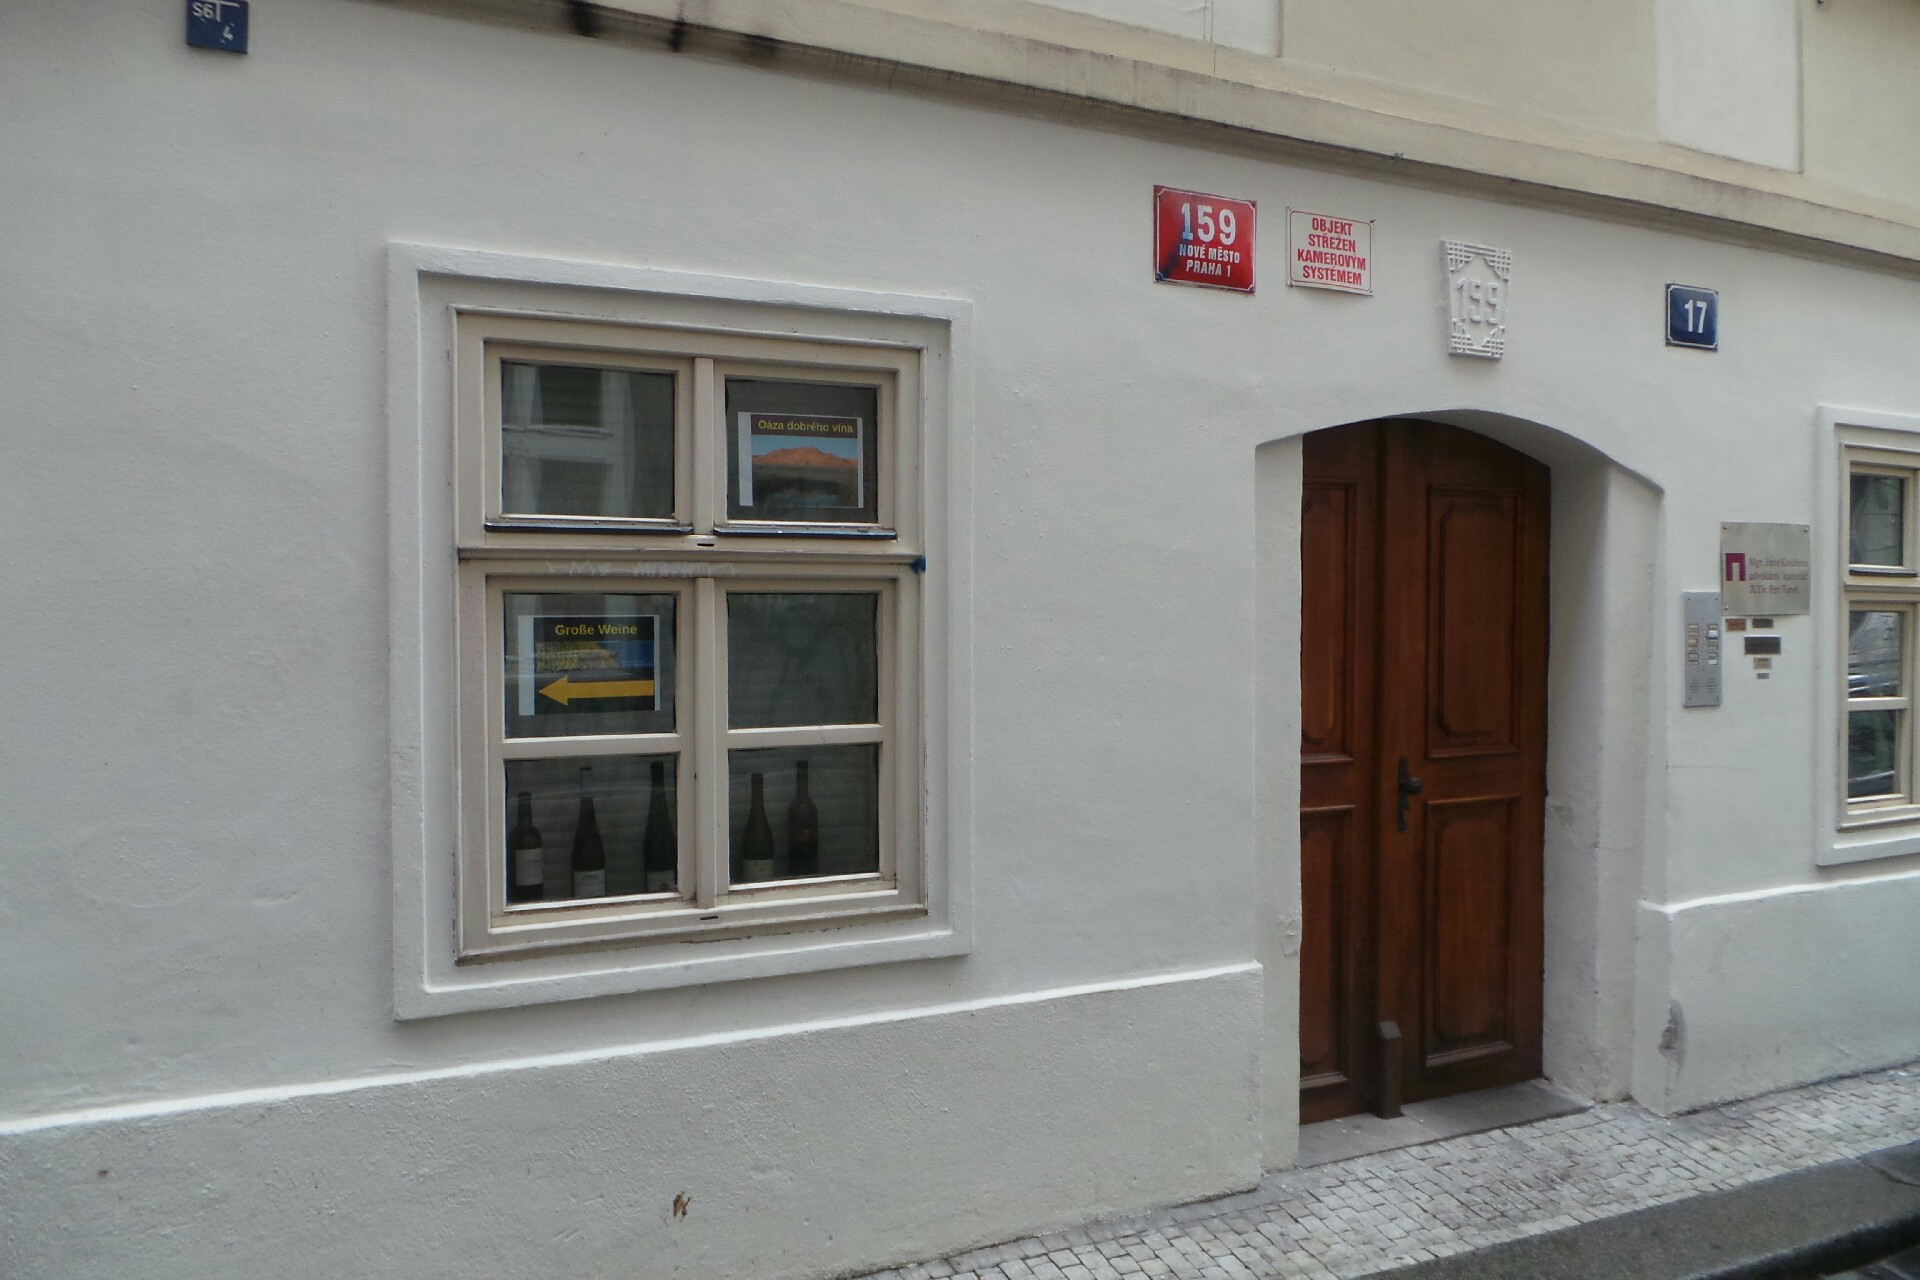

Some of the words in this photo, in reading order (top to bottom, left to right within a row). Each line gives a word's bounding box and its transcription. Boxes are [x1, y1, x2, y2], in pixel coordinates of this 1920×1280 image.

[1181, 202, 1236, 246] 159
[1312, 217, 1353, 236] OBJEKT
[1308, 232, 1356, 253] STŘEŽEN
[1179, 243, 1206, 259] NOVÉ
[1208, 246, 1240, 264] MĚSTO
[1297, 248, 1366, 270] KAMEROVÝM
[1186, 259, 1222, 276] PRAHA
[1226, 264, 1231, 278] 1
[1302, 265, 1362, 285] SYSTÉMEM
[1684, 299, 1707, 334] 17
[758, 420, 784, 430] Oáza
[786, 420, 829, 432] dobrého
[832, 423, 853, 433] vína
[554, 624, 594, 635] Große
[598, 624, 638, 635] Weine
